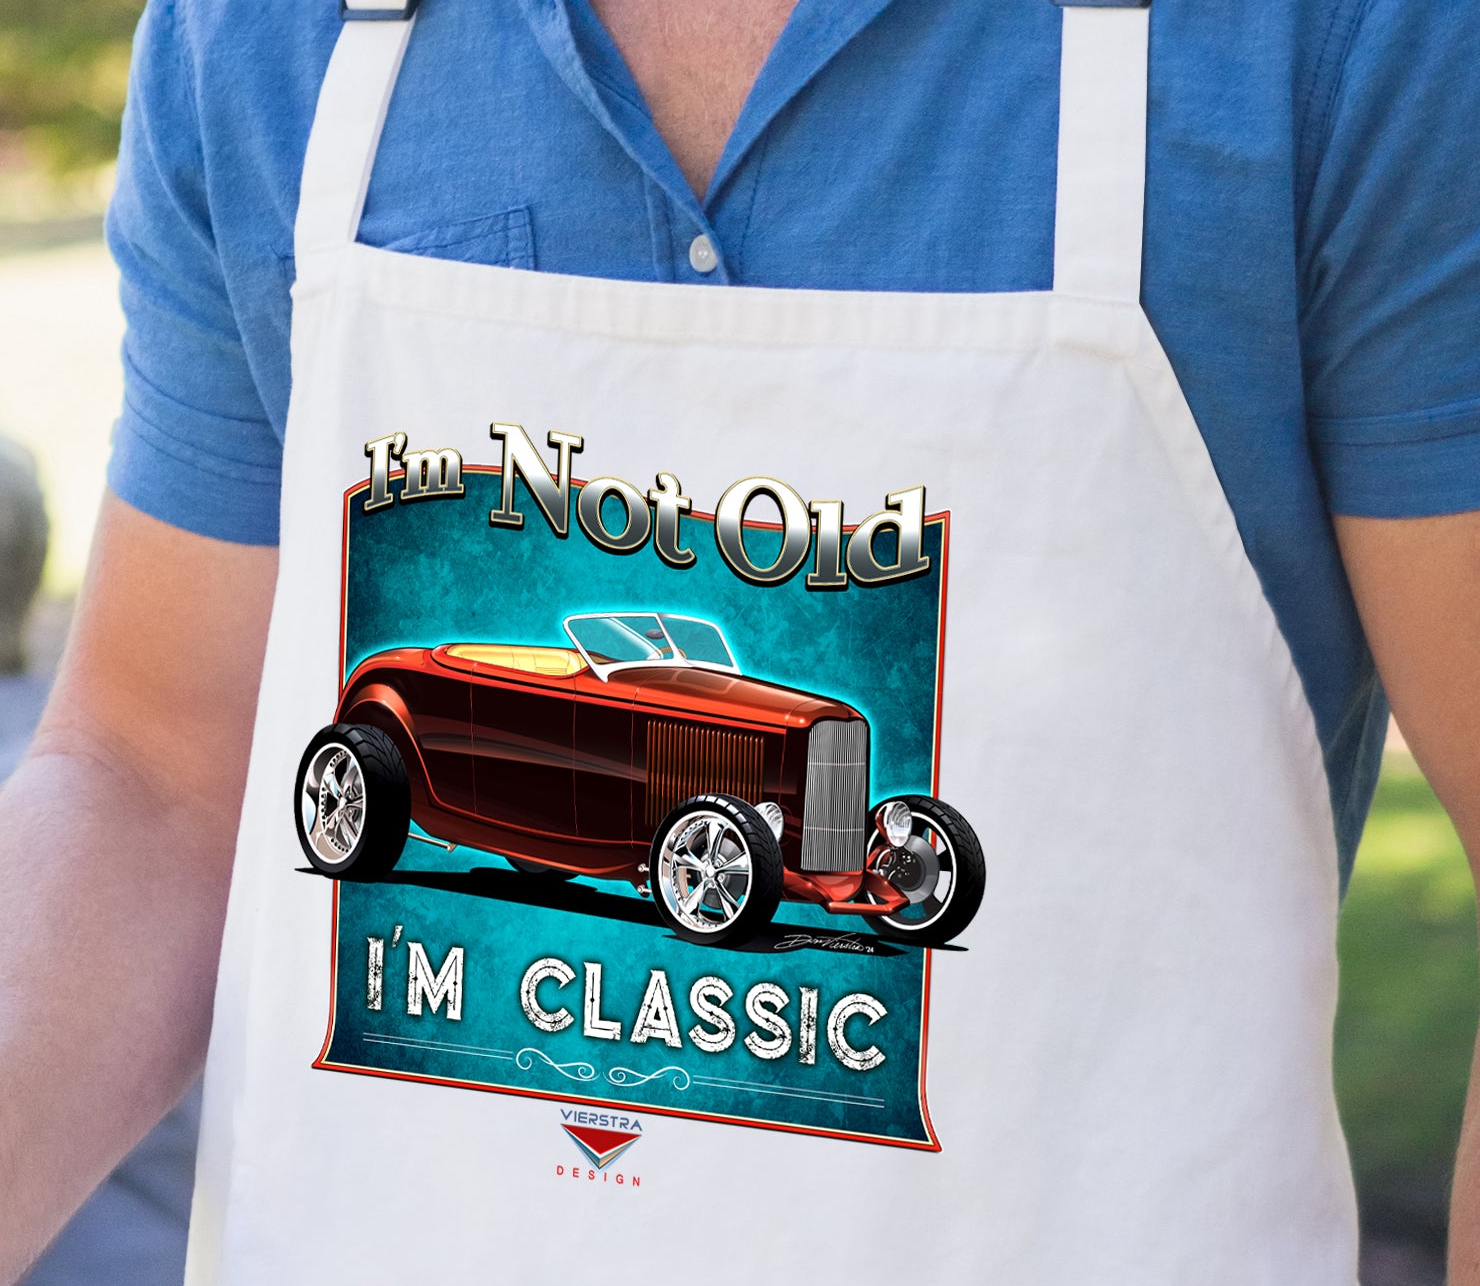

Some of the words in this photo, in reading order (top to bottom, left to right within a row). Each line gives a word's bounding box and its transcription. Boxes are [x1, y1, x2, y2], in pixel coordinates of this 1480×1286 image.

[363, 431, 465, 512] I'm
[491, 421, 697, 566] Not
[715, 475, 930, 588] Old
[366, 924, 465, 1021] I'M
[521, 956, 889, 1073] CLASSIC
[560, 1108, 643, 1132] VIERSTRA
[556, 1164, 641, 1187] DESIGN
